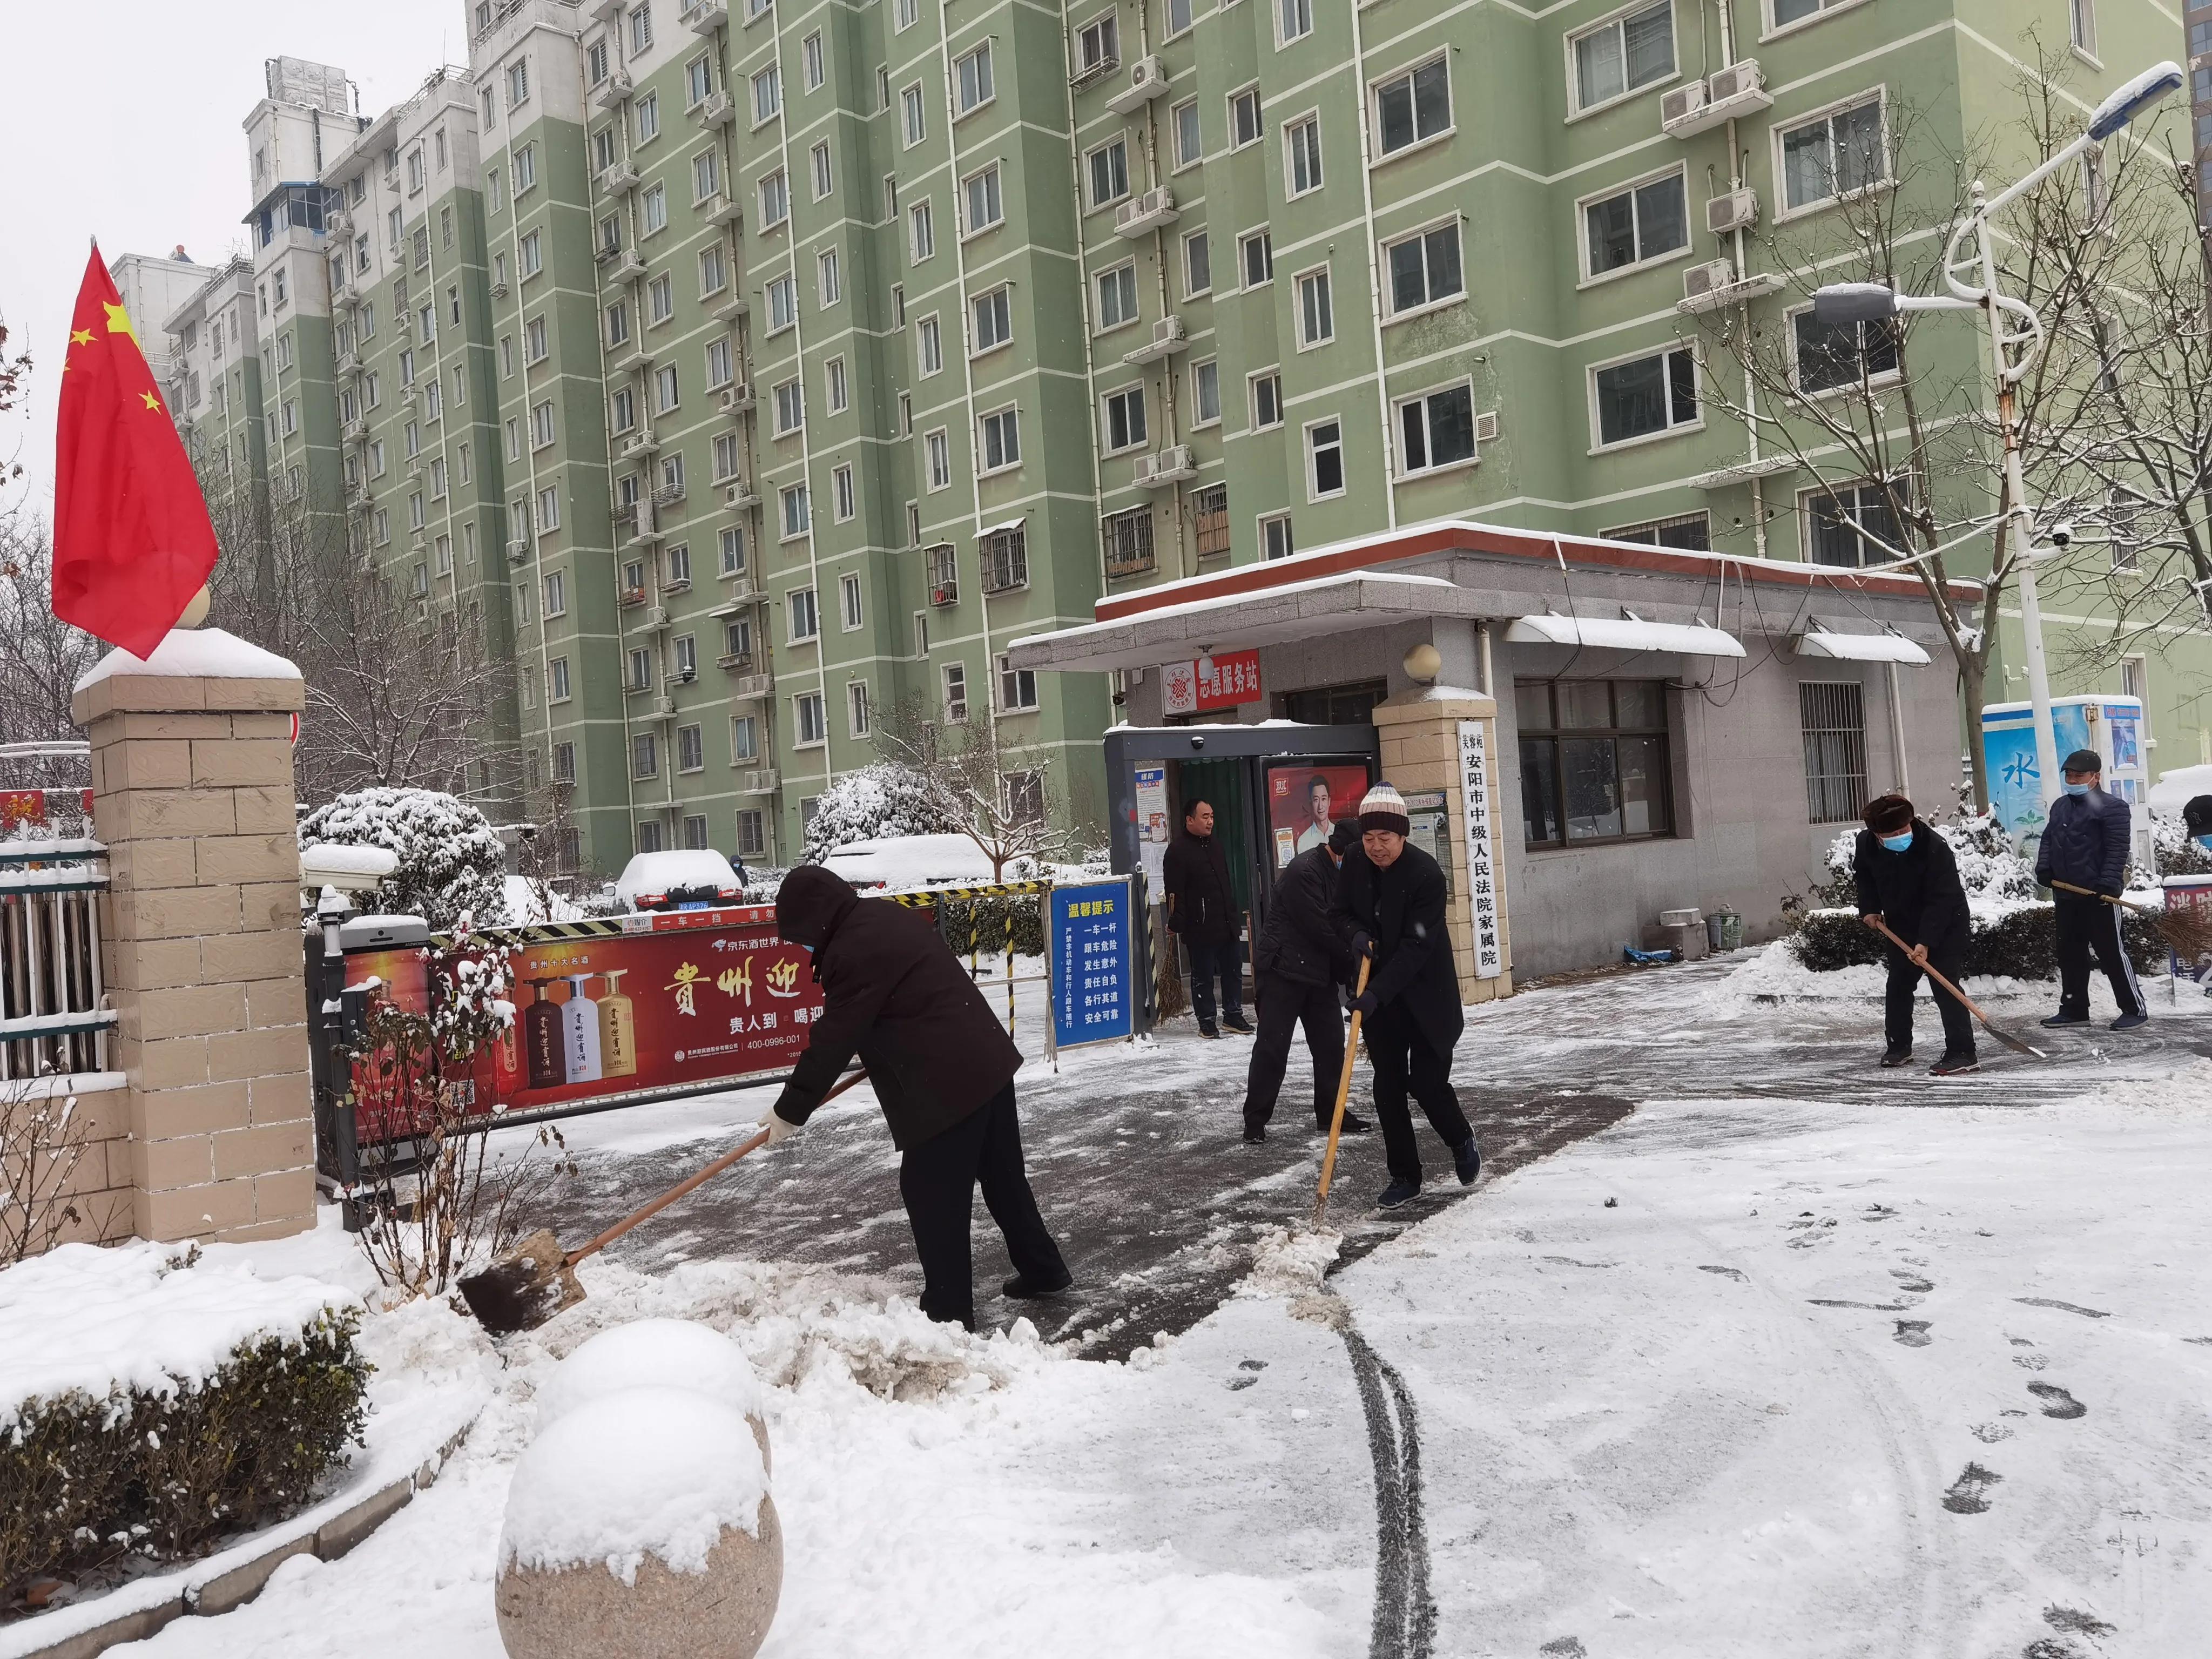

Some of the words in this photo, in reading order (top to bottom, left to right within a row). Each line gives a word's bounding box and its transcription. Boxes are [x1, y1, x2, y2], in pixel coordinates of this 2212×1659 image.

[1462, 734, 1483, 749] 芙蓉苑
[2001, 752, 2040, 789] 水
[1466, 754, 1496, 966] 安阳市中级人民法院家属院
[1069, 900, 1114, 918] 温馨提示
[661, 913, 721, 926] 一车一挡
[1084, 922, 1116, 935] 一车一杆
[727, 937, 779, 952] 京东酒世界
[1084, 940, 1117, 953] 跟车危险
[530, 955, 589, 970] 贵州十大名酒
[1084, 956, 1117, 971] 发生意外
[1084, 974, 1117, 989] 责任自负
[1084, 992, 1118, 1007] 各行其道
[730, 1012, 777, 1034] 贵人到
[1085, 1009, 1118, 1024] 安全可靠
[747, 1035, 800, 1050] 400-0996-001
